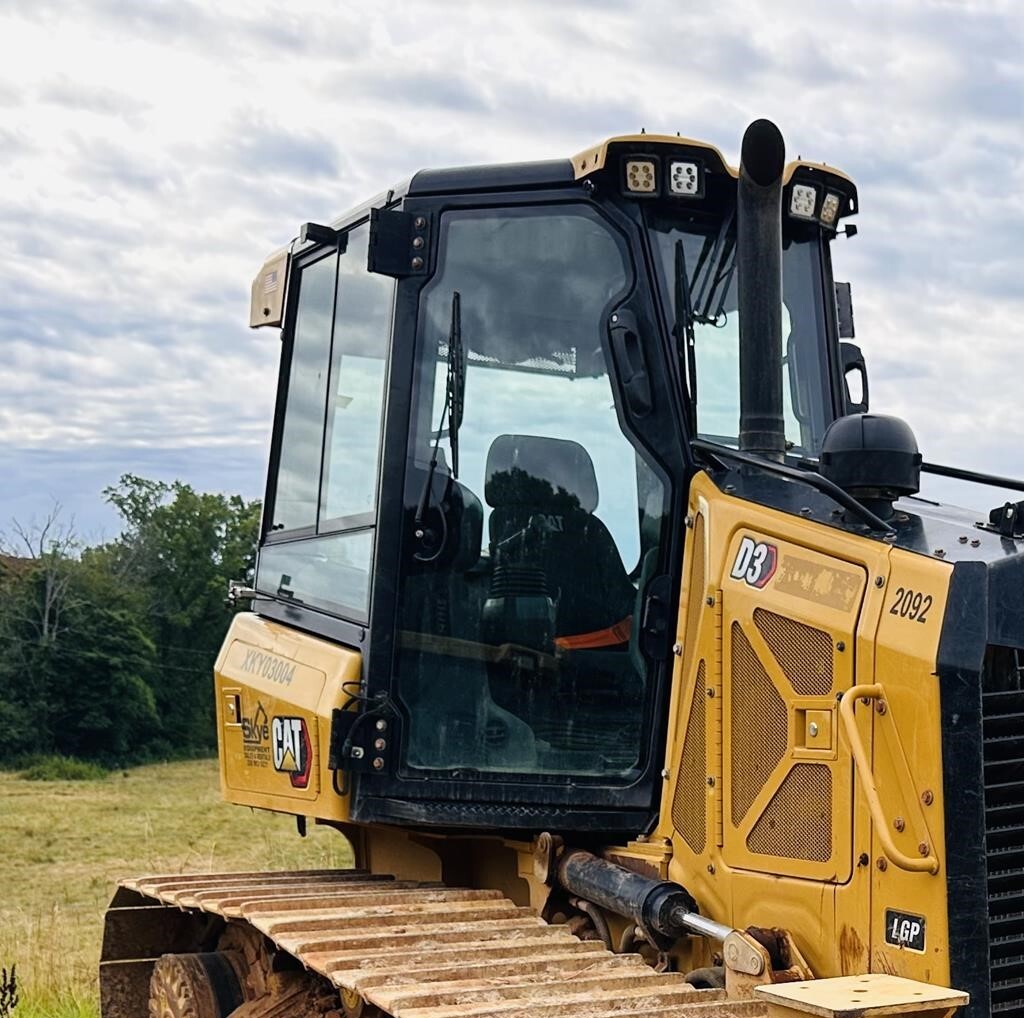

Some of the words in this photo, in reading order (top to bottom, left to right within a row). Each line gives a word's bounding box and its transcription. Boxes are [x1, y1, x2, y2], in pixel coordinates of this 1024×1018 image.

[731, 536, 768, 584] D3
[889, 587, 933, 624] 2092
[240, 649, 297, 686] XKY03004
[272, 717, 302, 772] CAT
[891, 918, 921, 942] LGP
